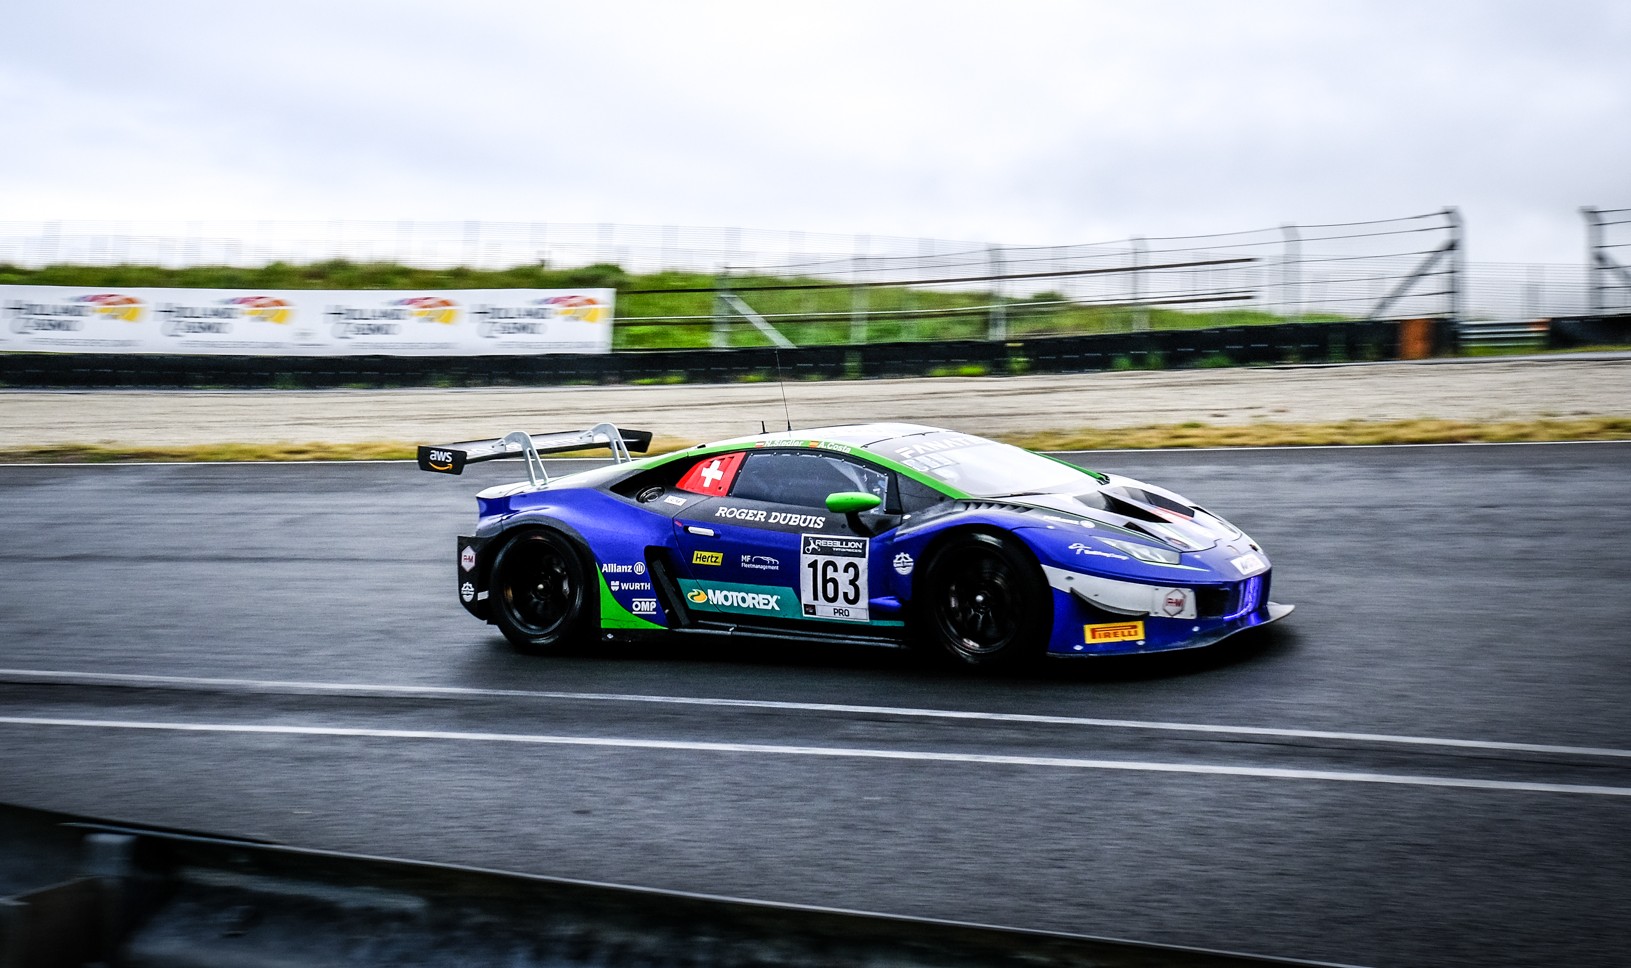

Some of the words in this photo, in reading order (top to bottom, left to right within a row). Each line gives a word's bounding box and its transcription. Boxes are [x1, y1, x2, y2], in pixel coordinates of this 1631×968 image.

[429, 450, 453, 463] aws
[715, 506, 767, 522] ROGER
[768, 511, 826, 529] DUBUIS
[815, 539, 863, 549] REBELLION
[695, 552, 720, 564] Hertz
[601, 563, 633, 573] Allianz
[741, 562, 779, 570] Fleetmanagement
[807, 558, 861, 606] 163
[707, 588, 780, 611] MOTOREX
[632, 601, 657, 611] OMP
[833, 608, 850, 617] PRO
[1090, 624, 1138, 640] PIRELLI
